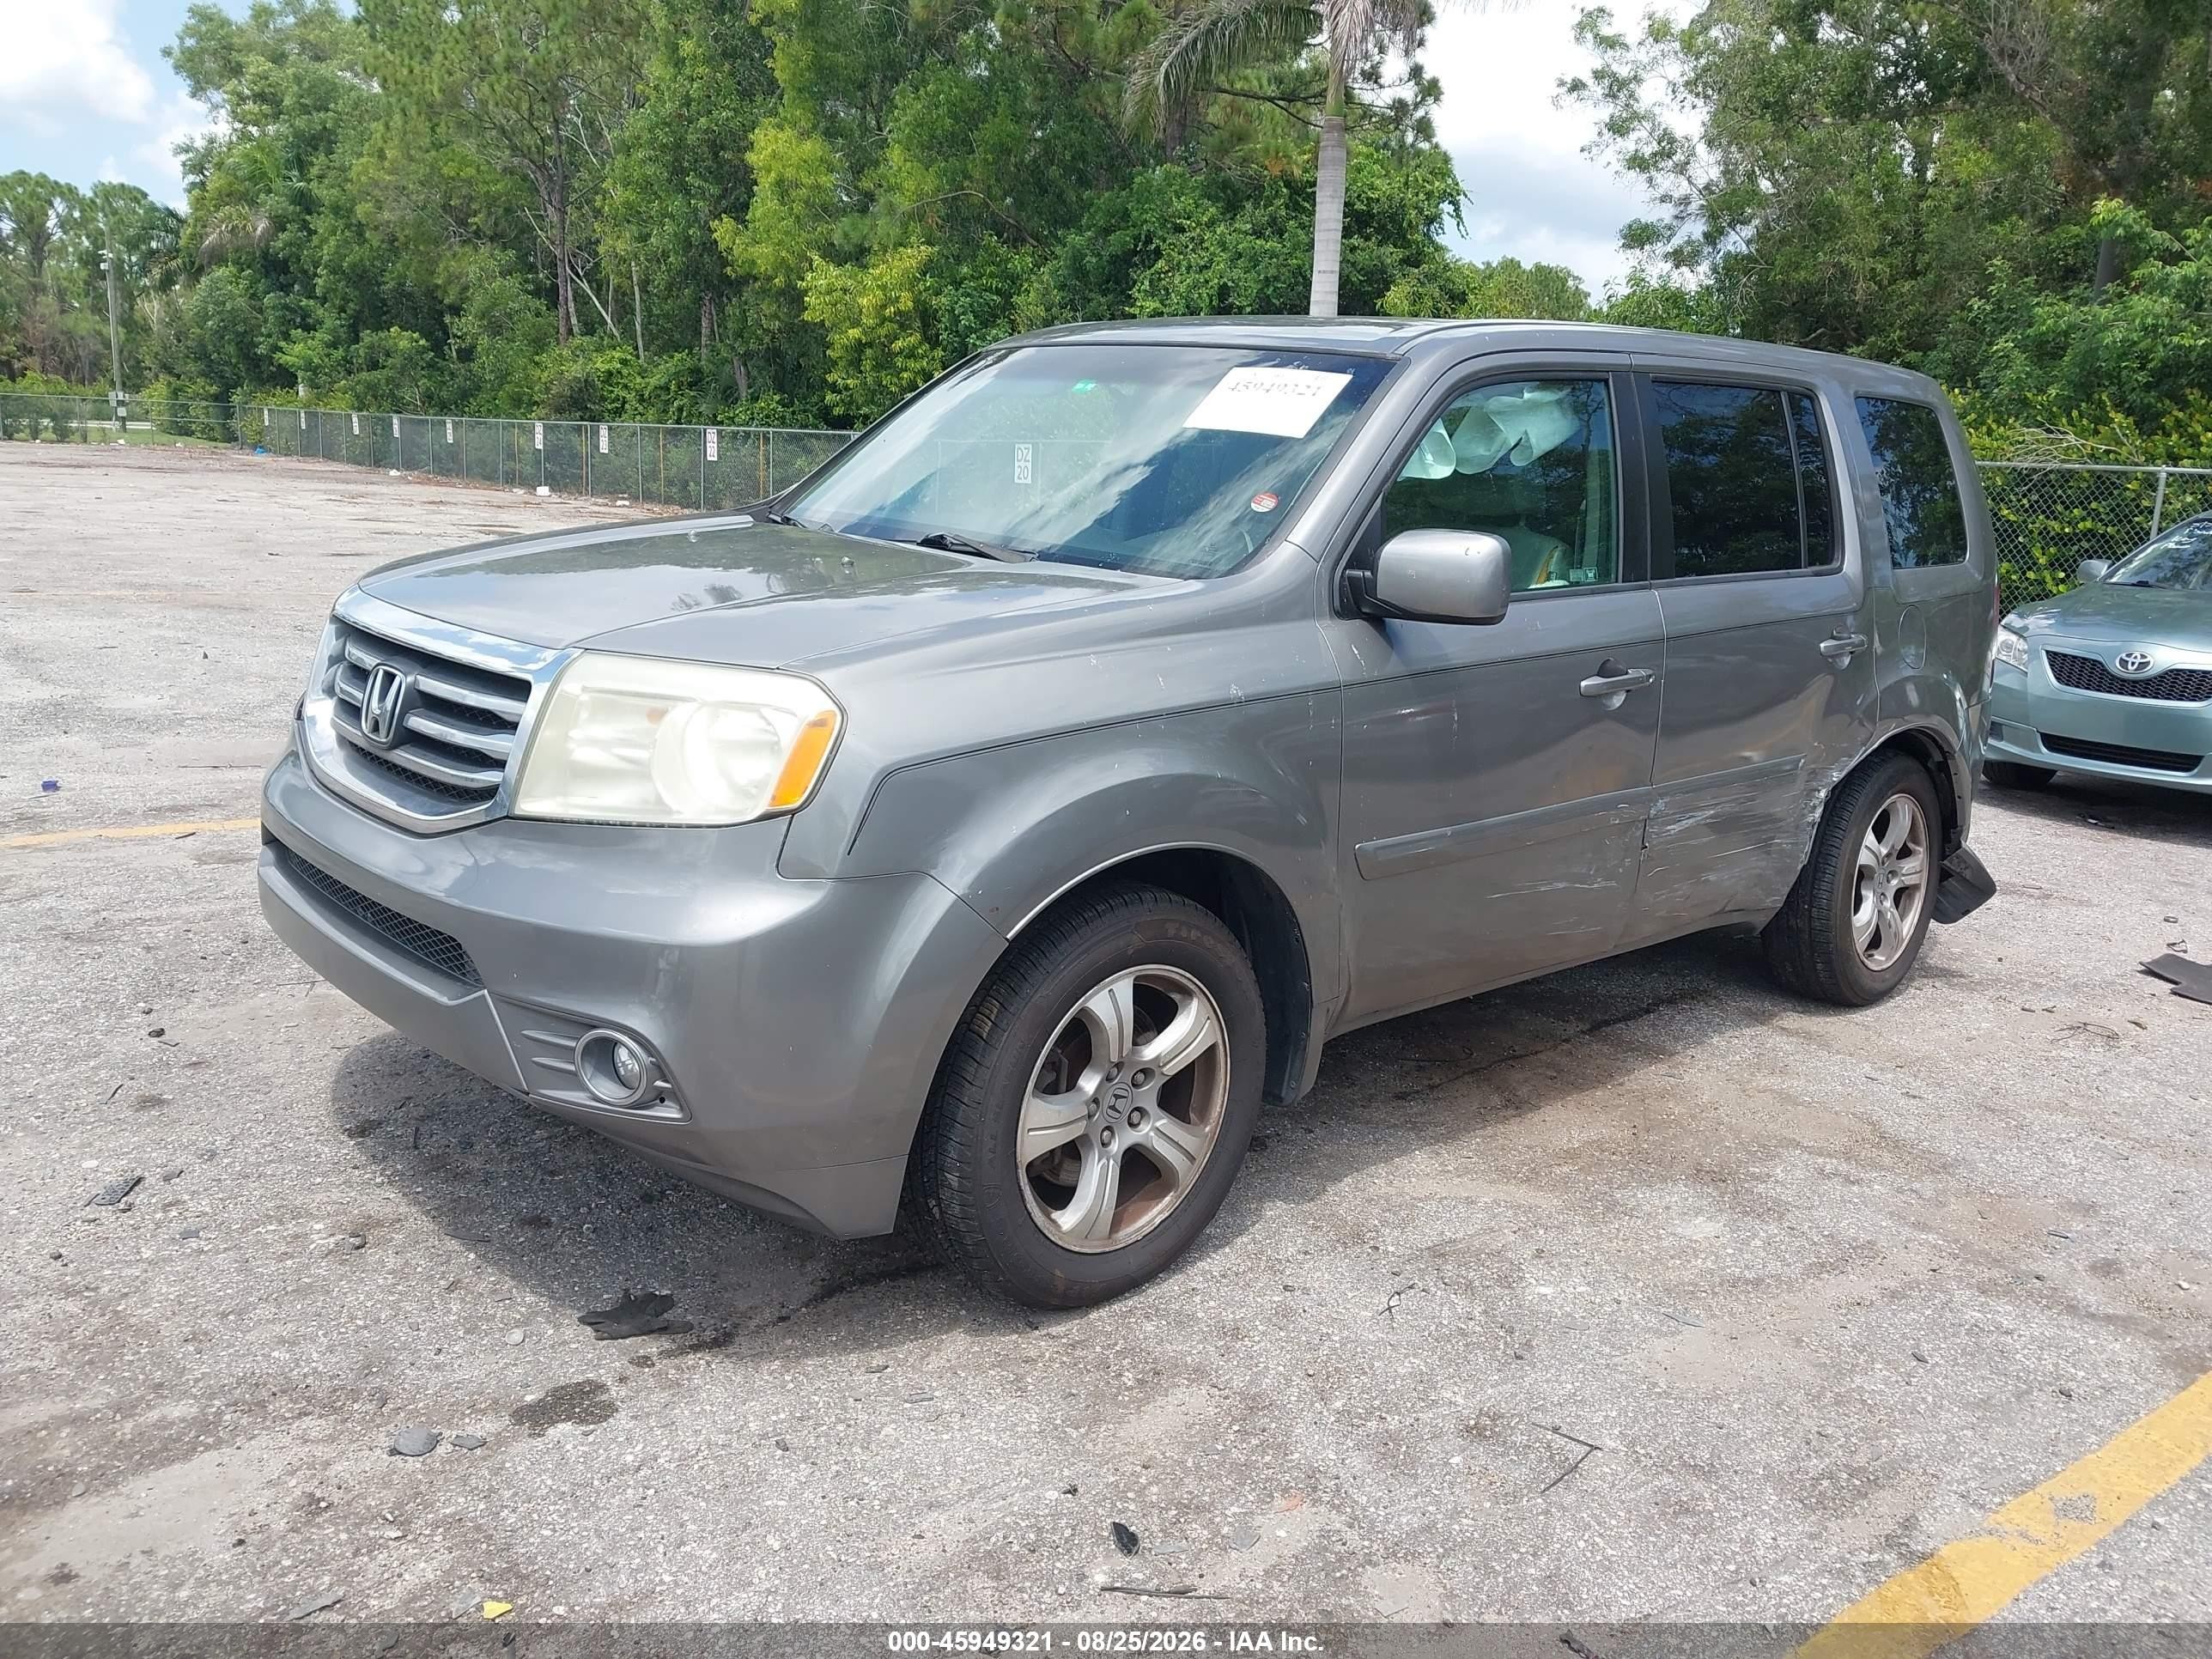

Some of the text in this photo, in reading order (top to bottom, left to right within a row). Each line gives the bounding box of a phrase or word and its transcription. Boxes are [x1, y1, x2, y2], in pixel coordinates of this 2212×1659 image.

[708, 430, 716, 444] DZ
[708, 445, 716, 459] 22
[1017, 447, 1030, 462] DZ
[1018, 465, 1030, 480] 20
